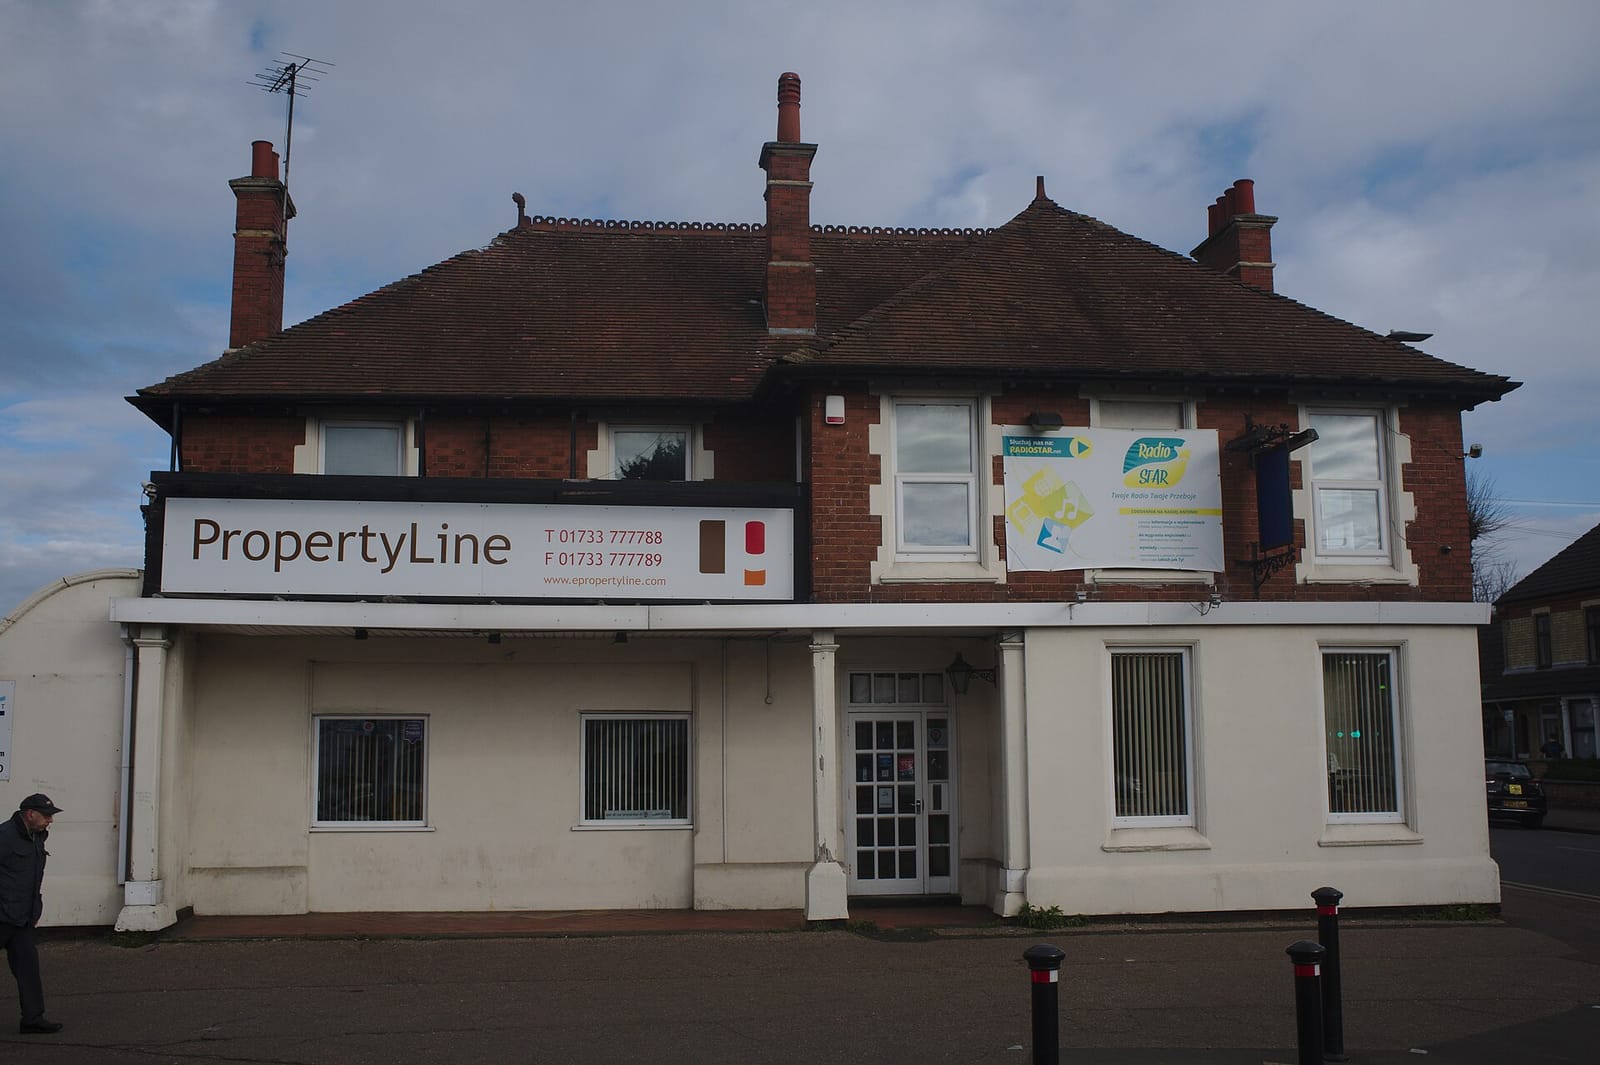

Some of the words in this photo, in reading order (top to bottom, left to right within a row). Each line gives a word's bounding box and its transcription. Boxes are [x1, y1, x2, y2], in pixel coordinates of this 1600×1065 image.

[1138, 441, 1171, 459] Radio
[1138, 468, 1169, 485] STAR
[1111, 492, 1130, 500] Twoje
[1130, 492, 1149, 500] Radio
[1150, 492, 1168, 501] Twoje
[1169, 493, 1197, 502] Przeboje
[544, 529, 555, 543] T
[559, 529, 604, 544] 01733
[609, 530, 663, 545] 777788
[192, 518, 511, 574] PropertyLine
[545, 552, 554, 566] F
[559, 552, 603, 566] 01733
[609, 553, 662, 567] 777789
[543, 575, 666, 588] www.epropertyline.com
